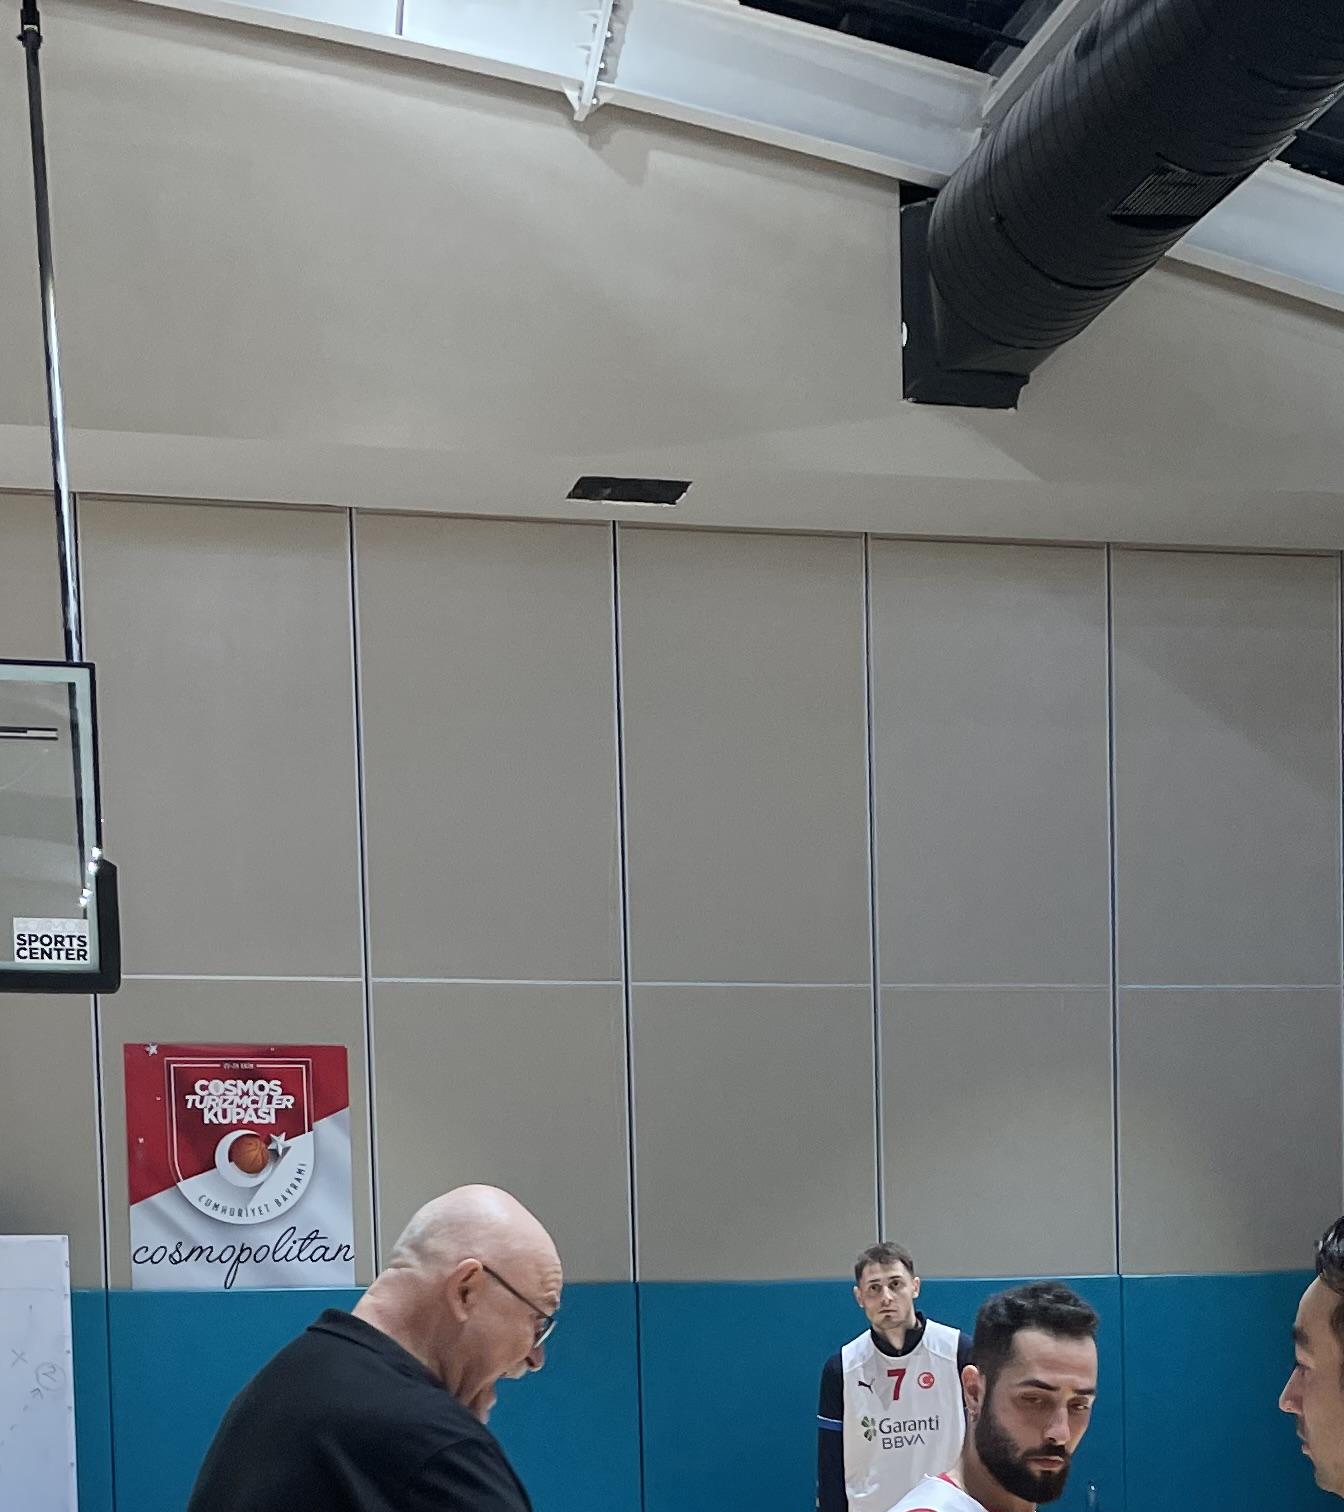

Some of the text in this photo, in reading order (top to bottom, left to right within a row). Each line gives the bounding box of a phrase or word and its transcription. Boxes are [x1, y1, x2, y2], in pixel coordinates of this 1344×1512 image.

[16, 933, 88, 947] SPORTS
[16, 947, 88, 960] CENTER
[194, 1080, 283, 1096] COSMOS
[203, 1108, 276, 1124] KUPASI
[132, 1226, 354, 1289] cosmopolitan
[887, 1368, 906, 1401] 7
[878, 1414, 940, 1435] Garanti
[882, 1433, 926, 1450] BBVA
